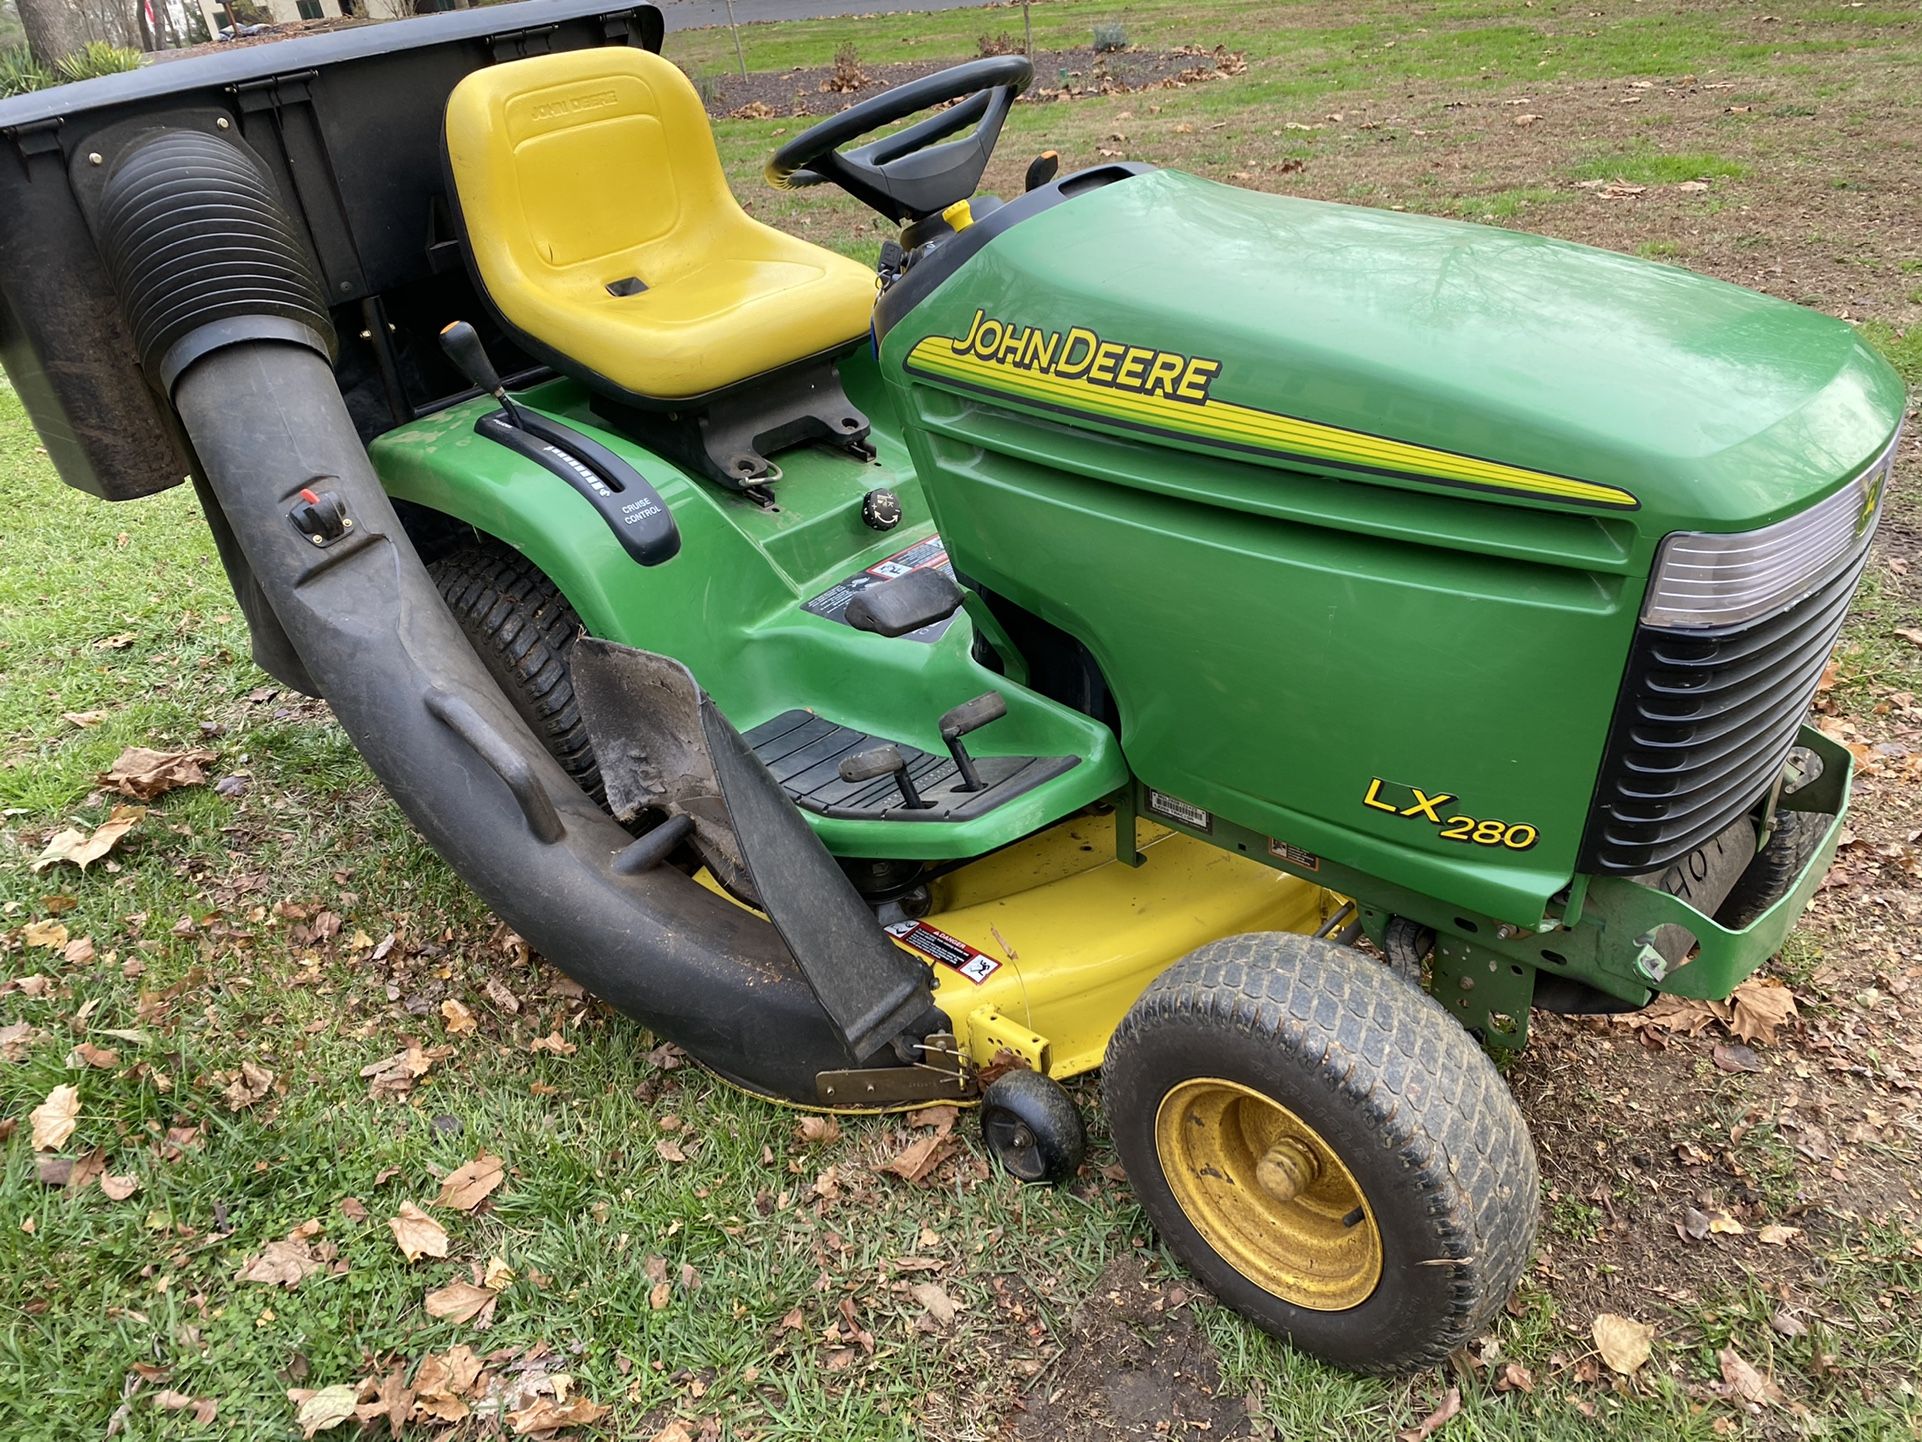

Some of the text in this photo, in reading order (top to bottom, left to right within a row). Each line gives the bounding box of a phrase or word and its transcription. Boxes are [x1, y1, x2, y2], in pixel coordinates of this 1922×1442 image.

[951, 308, 1222, 406] JOHN DEERE
[621, 497, 651, 514] CRUISE
[624, 505, 662, 525] CONTROL
[939, 932, 967, 949] DANGER
